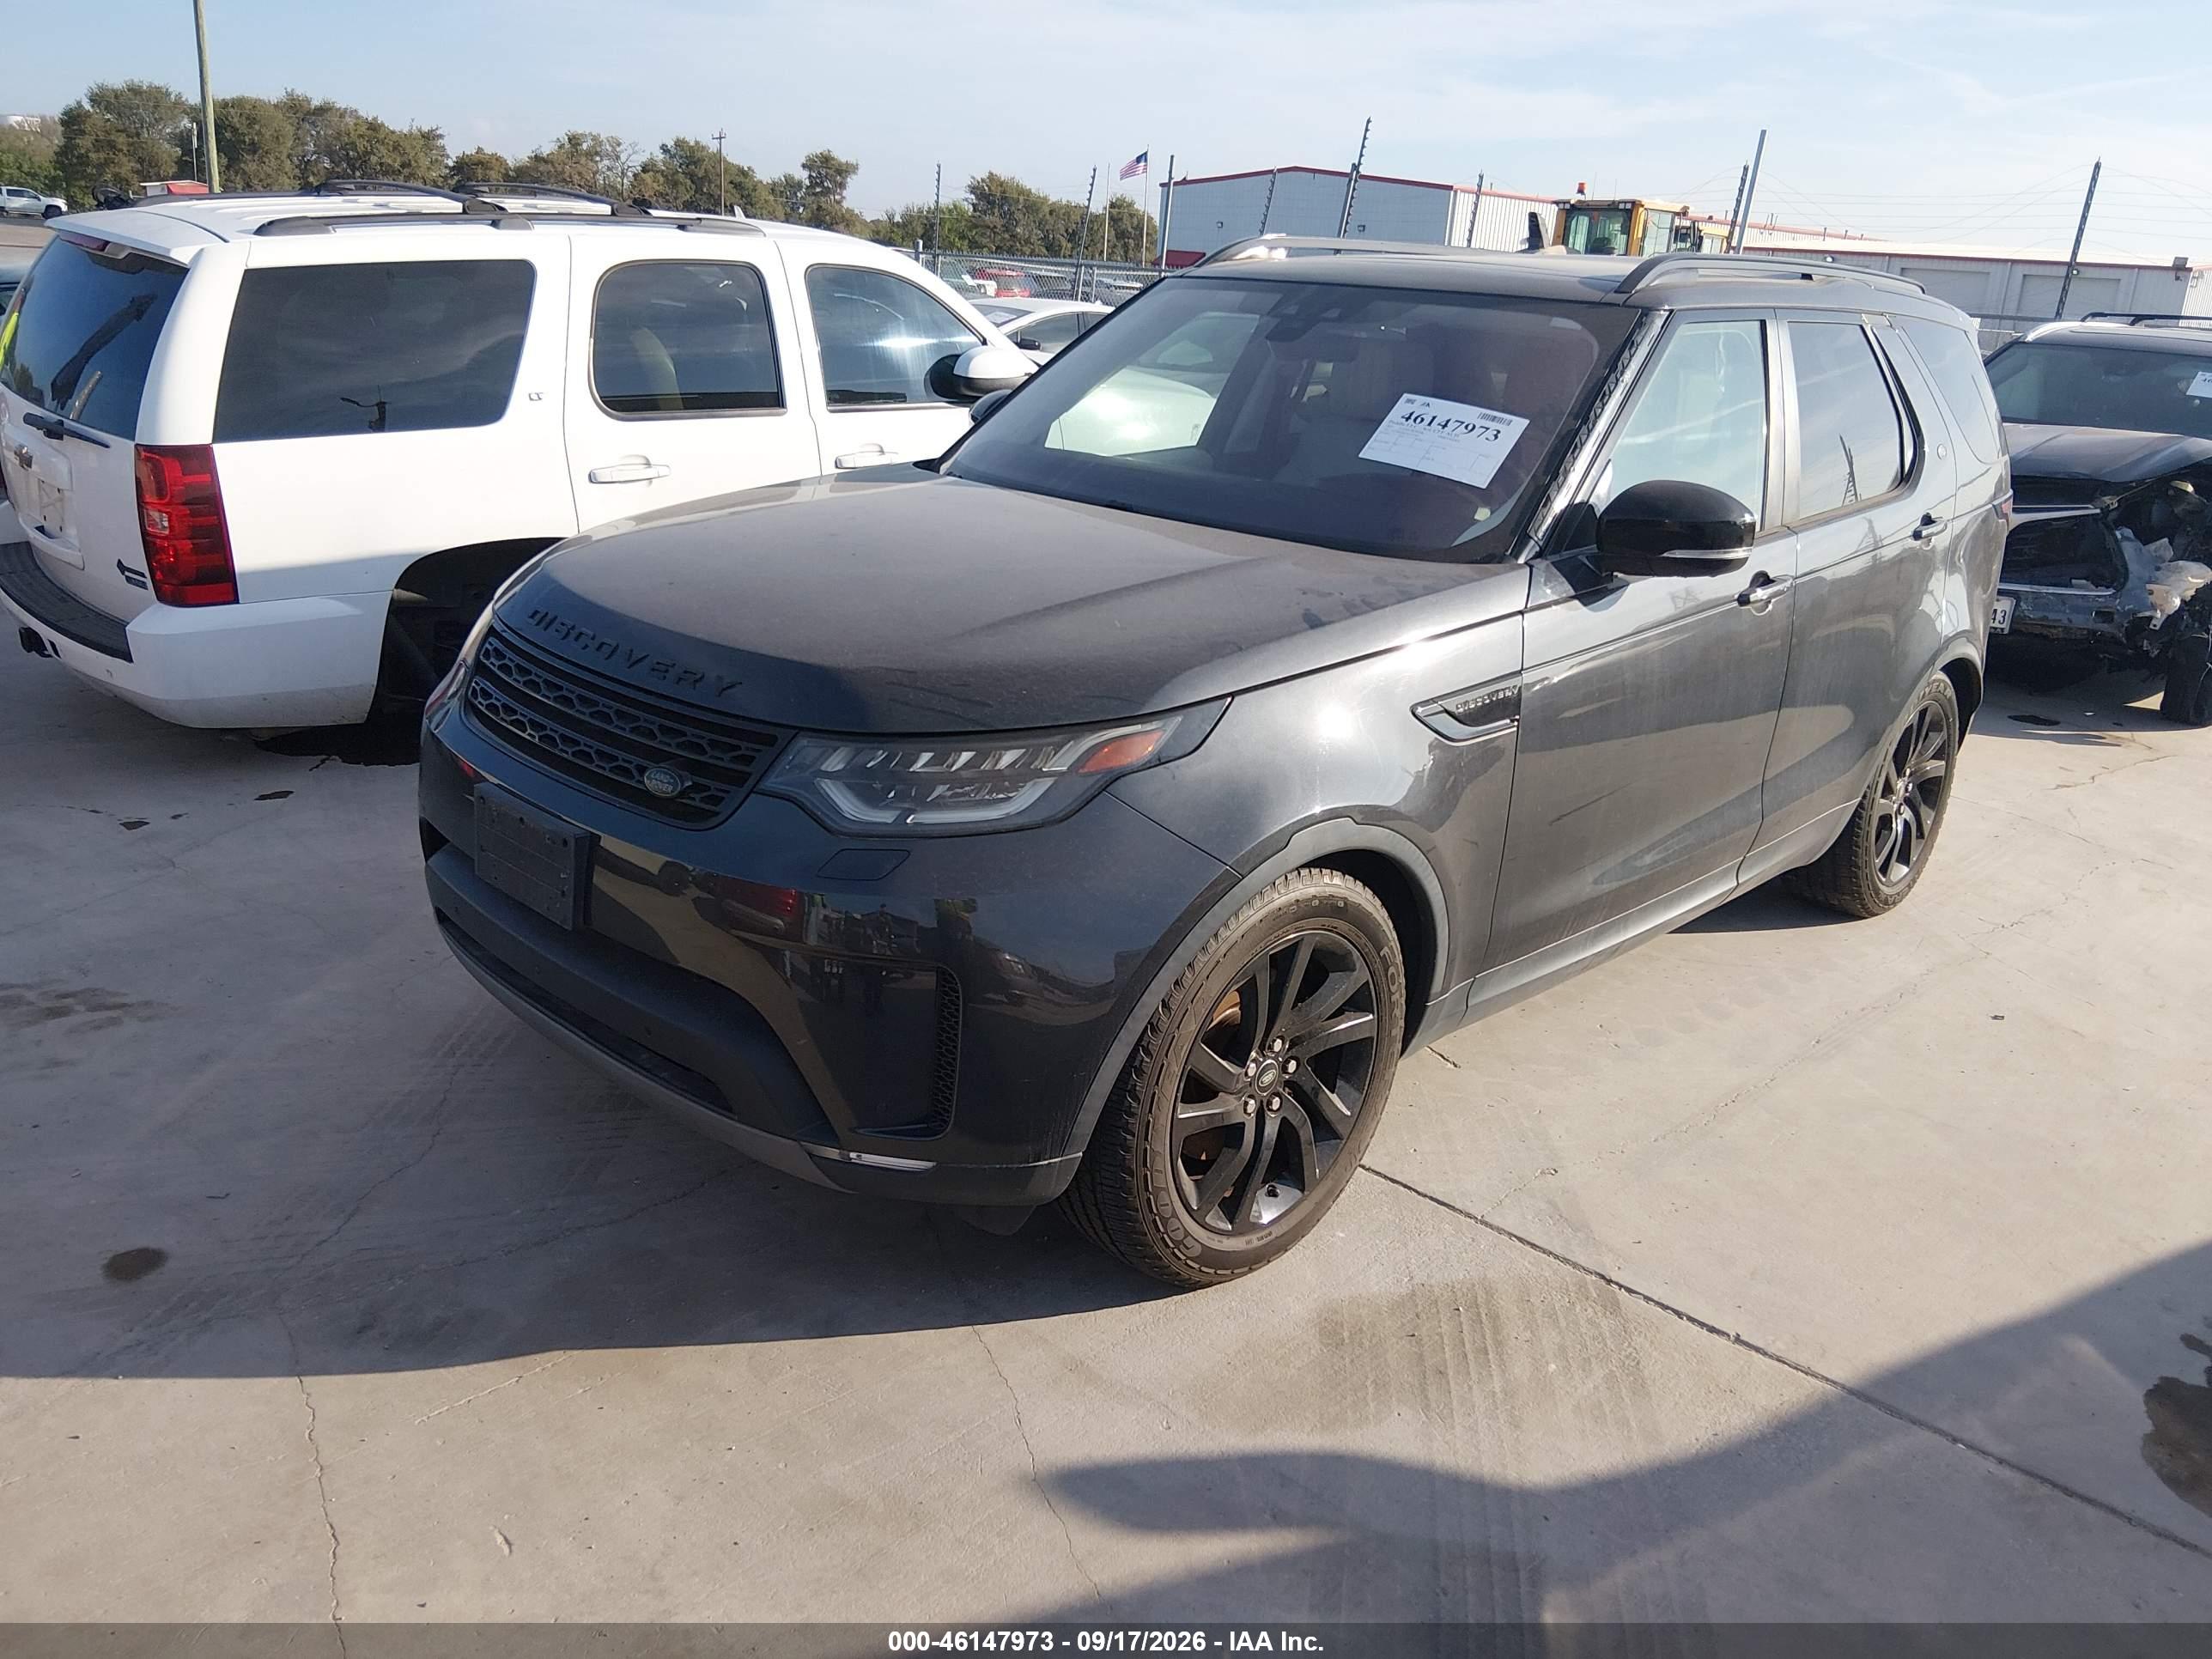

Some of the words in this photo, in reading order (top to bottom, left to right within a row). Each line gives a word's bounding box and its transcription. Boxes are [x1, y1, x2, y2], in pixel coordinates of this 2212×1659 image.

[1401, 410, 1502, 442] 46147973
[527, 609, 743, 697] DISCOVERY
[1455, 684, 1519, 714] DISCOVERY
